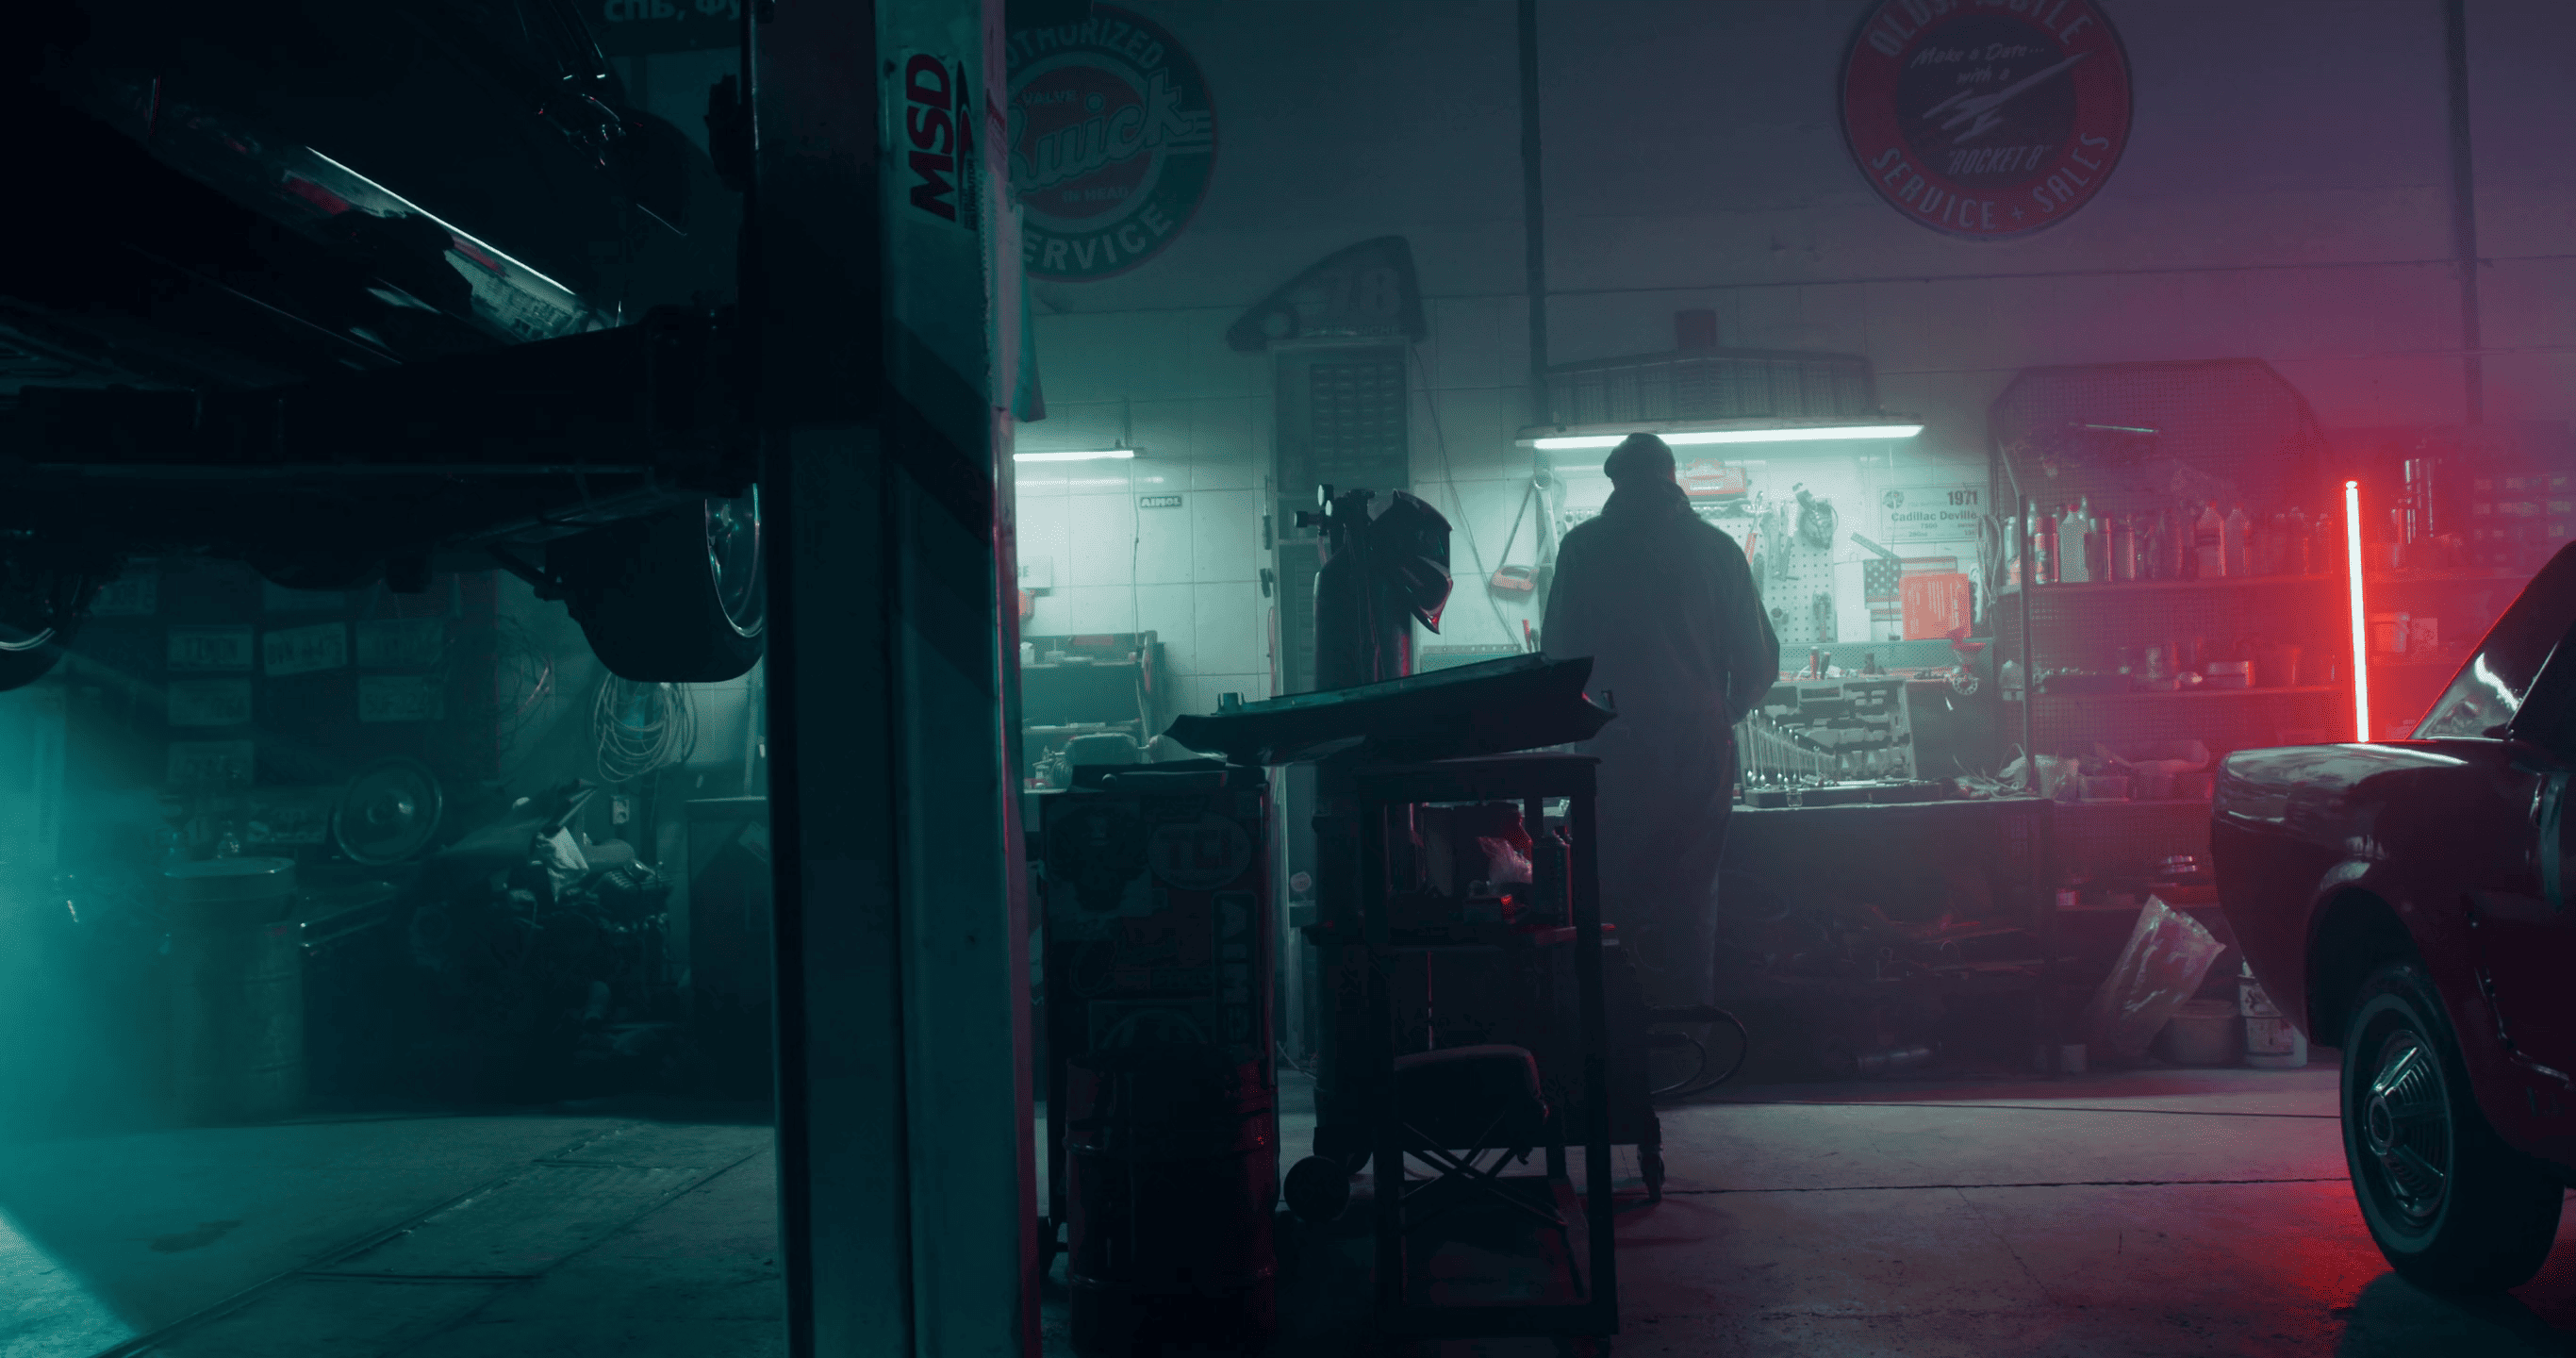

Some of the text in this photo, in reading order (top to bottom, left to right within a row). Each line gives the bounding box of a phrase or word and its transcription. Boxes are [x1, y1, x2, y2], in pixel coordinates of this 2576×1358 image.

[1909, 46, 1965, 69] Make
[1956, 64, 1993, 85] with
[905, 54, 956, 224] MSD
[1872, 132, 2110, 229] SERVICE SALES
[1023, 201, 1175, 271] ERVICE
[1891, 510, 1977, 522] Cadillac Deville
[1946, 489, 1978, 506] 1971
[1221, 899, 1249, 1041] AIMO
